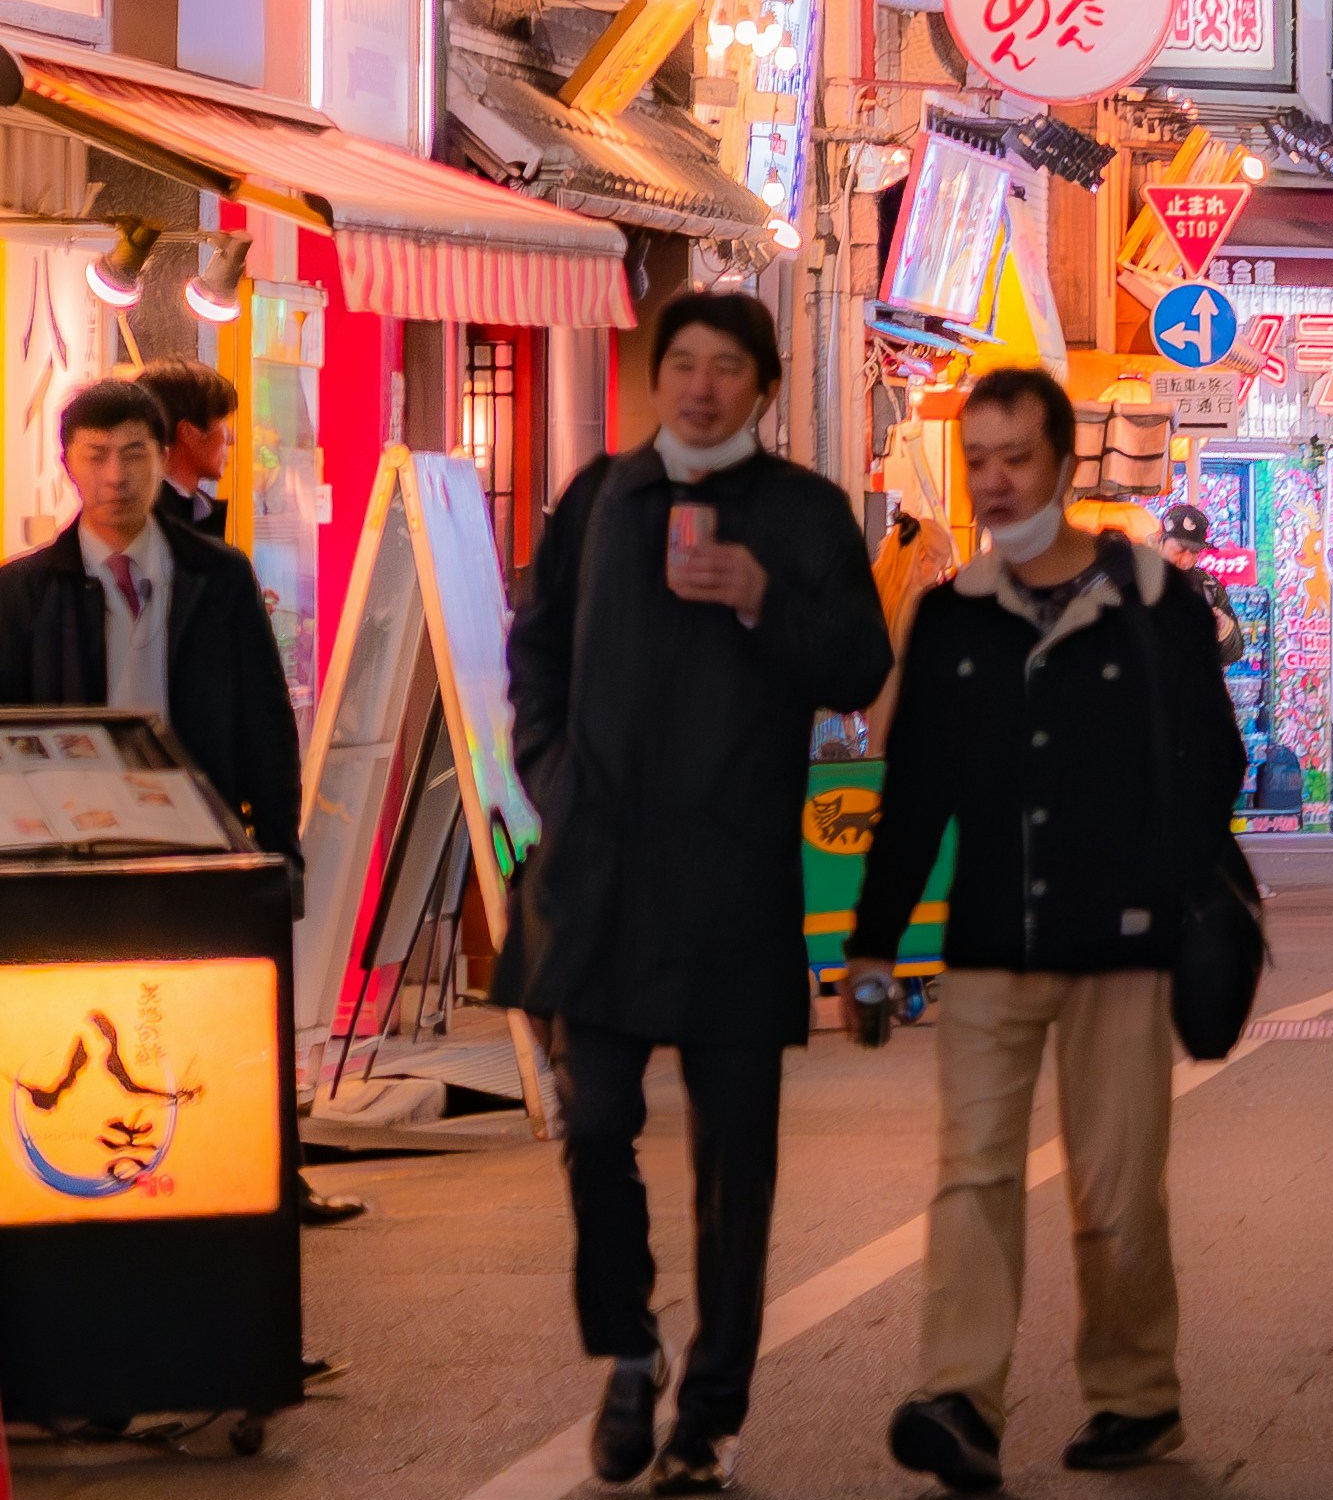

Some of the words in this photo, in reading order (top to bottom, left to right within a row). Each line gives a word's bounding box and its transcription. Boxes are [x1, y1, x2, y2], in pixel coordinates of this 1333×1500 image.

[1165, 195, 1227, 216] 止まれ
[1176, 220, 1218, 241] STOP
[1176, 397, 1234, 415] 方通行
